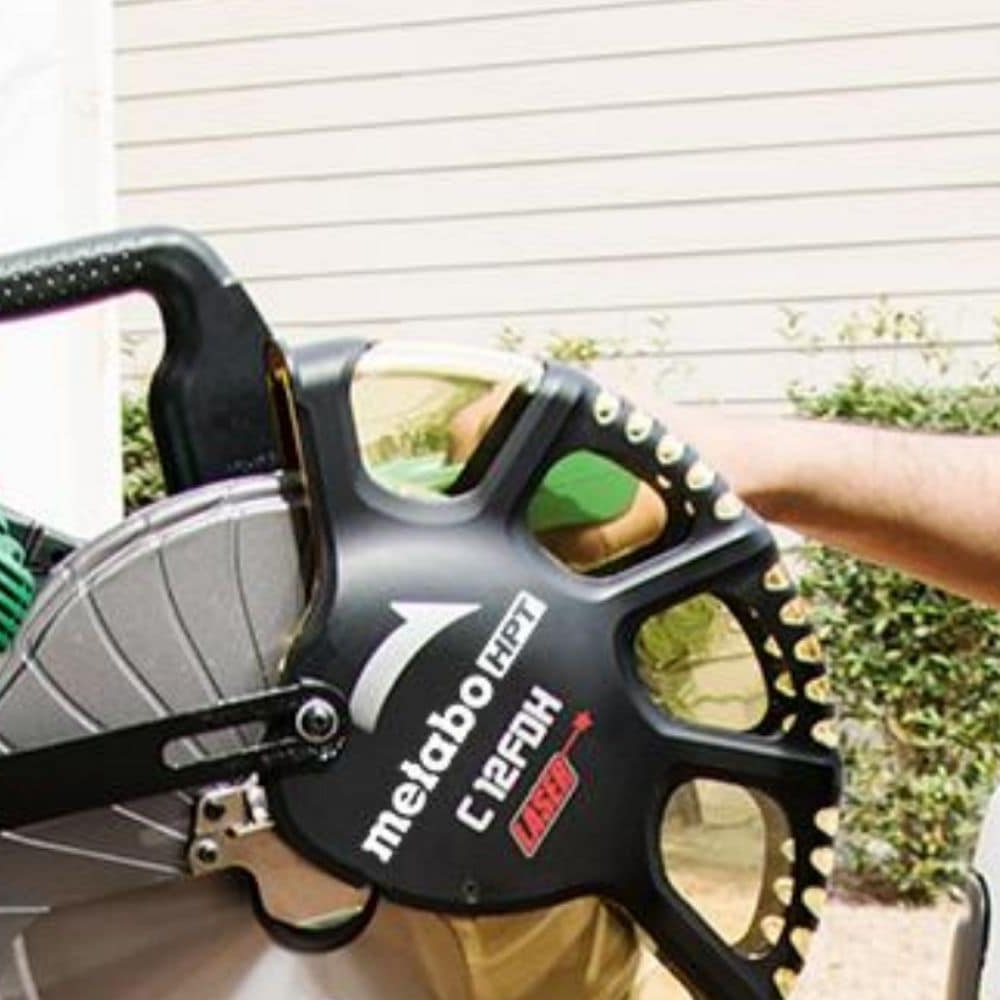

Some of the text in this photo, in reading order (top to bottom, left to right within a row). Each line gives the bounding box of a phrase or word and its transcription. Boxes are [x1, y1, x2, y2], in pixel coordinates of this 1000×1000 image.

[361, 593, 544, 863] metabo HPT
[456, 685, 564, 833] C 12FDH
[512, 755, 575, 851] LASER
